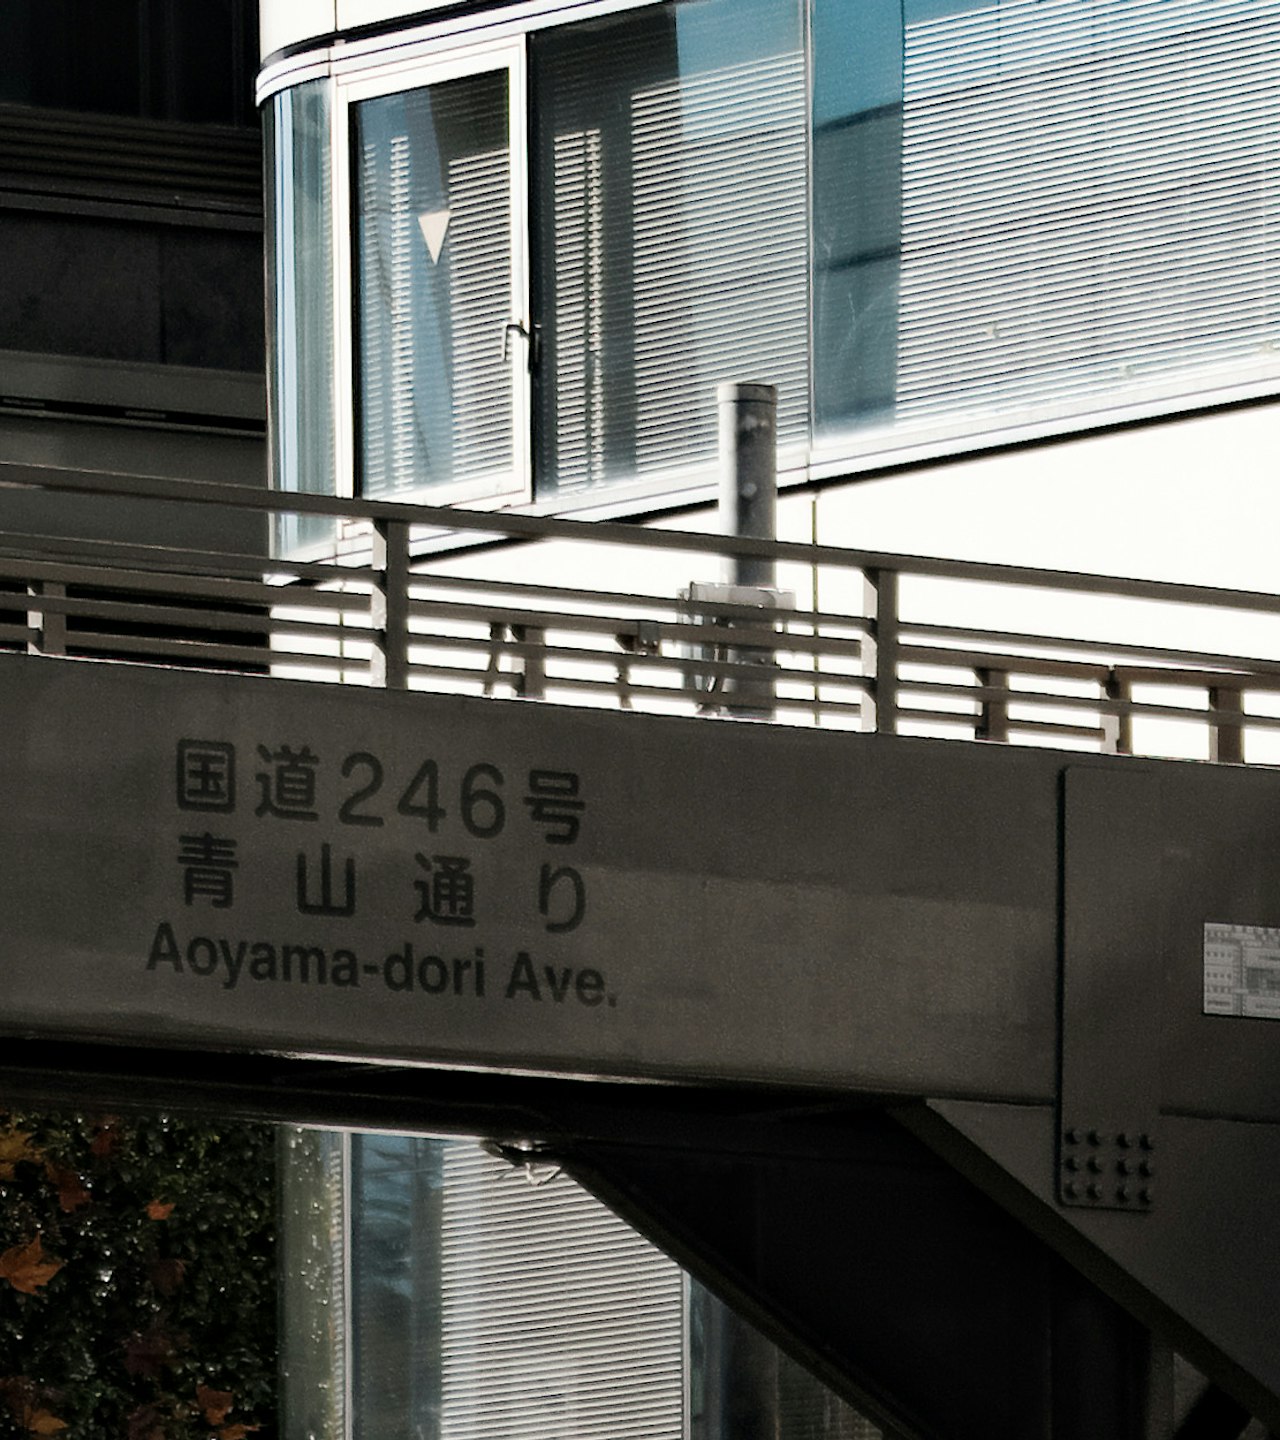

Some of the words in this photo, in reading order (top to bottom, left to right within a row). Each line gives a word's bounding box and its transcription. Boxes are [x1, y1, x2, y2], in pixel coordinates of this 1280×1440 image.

[176, 738, 586, 846] 国道246号
[145, 922, 487, 998] Aoyama-dori
[505, 951, 618, 1008] Ave.
